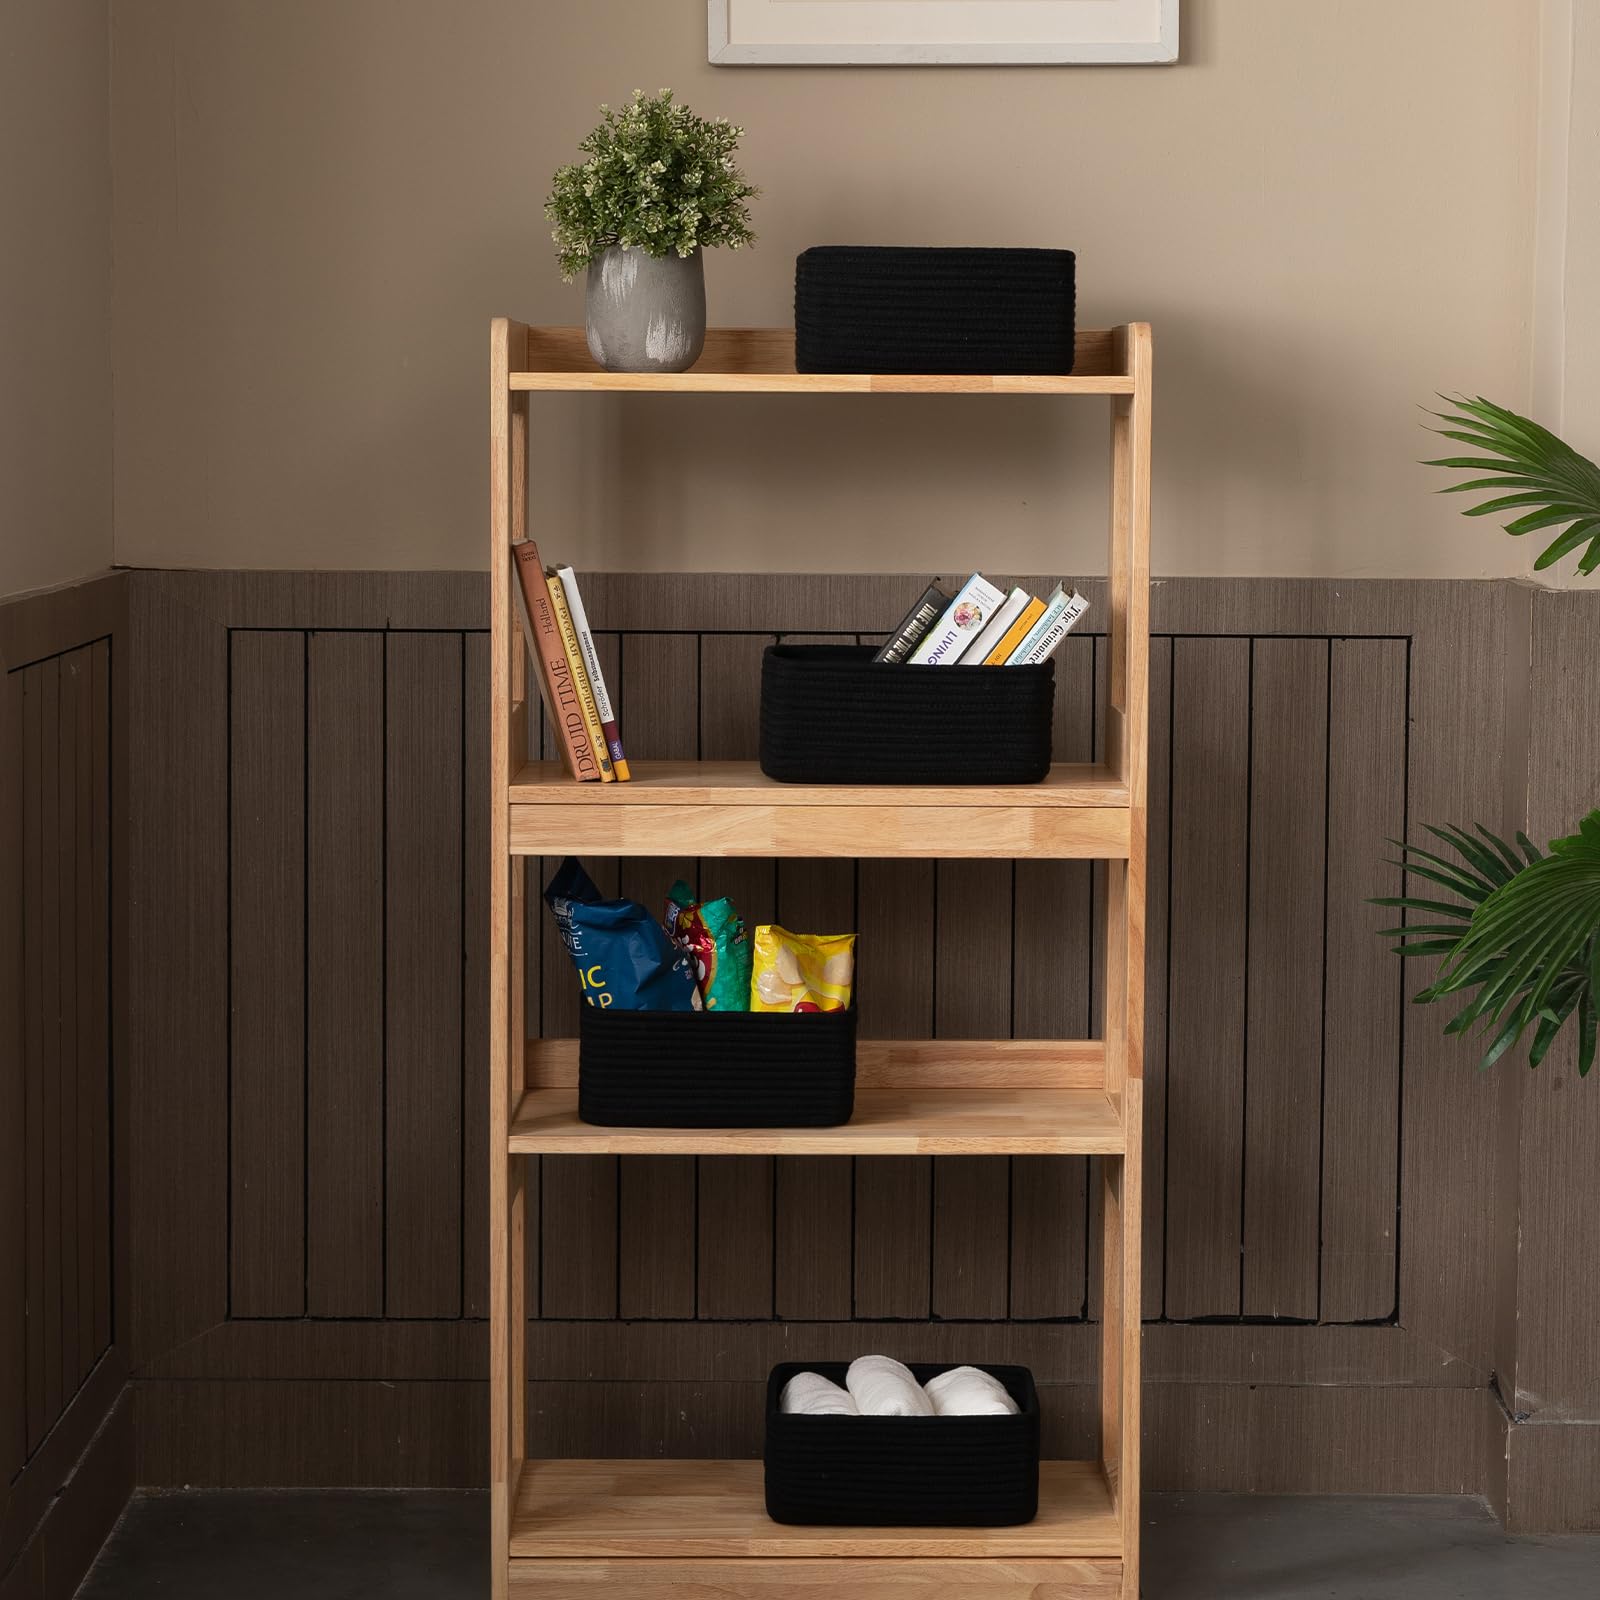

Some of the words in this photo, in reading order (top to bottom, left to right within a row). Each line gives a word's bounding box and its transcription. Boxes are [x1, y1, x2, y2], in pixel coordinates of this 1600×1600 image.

[536, 598, 555, 635] Holland
[902, 619, 925, 643] BACK
[916, 603, 938, 625] TAKE
[1061, 604, 1081, 624] The
[581, 631, 600, 682] Selbstmanagement
[893, 637, 912, 655] THE
[927, 630, 958, 665] LIVING
[1028, 624, 1065, 664] Grimoire
[550, 657, 577, 711] TIME
[559, 606, 579, 657] РУССКАЯ
[575, 664, 600, 727] ТВЕРДЫНЯ
[596, 685, 610, 717] Schröder
[566, 712, 595, 773] DRUID
